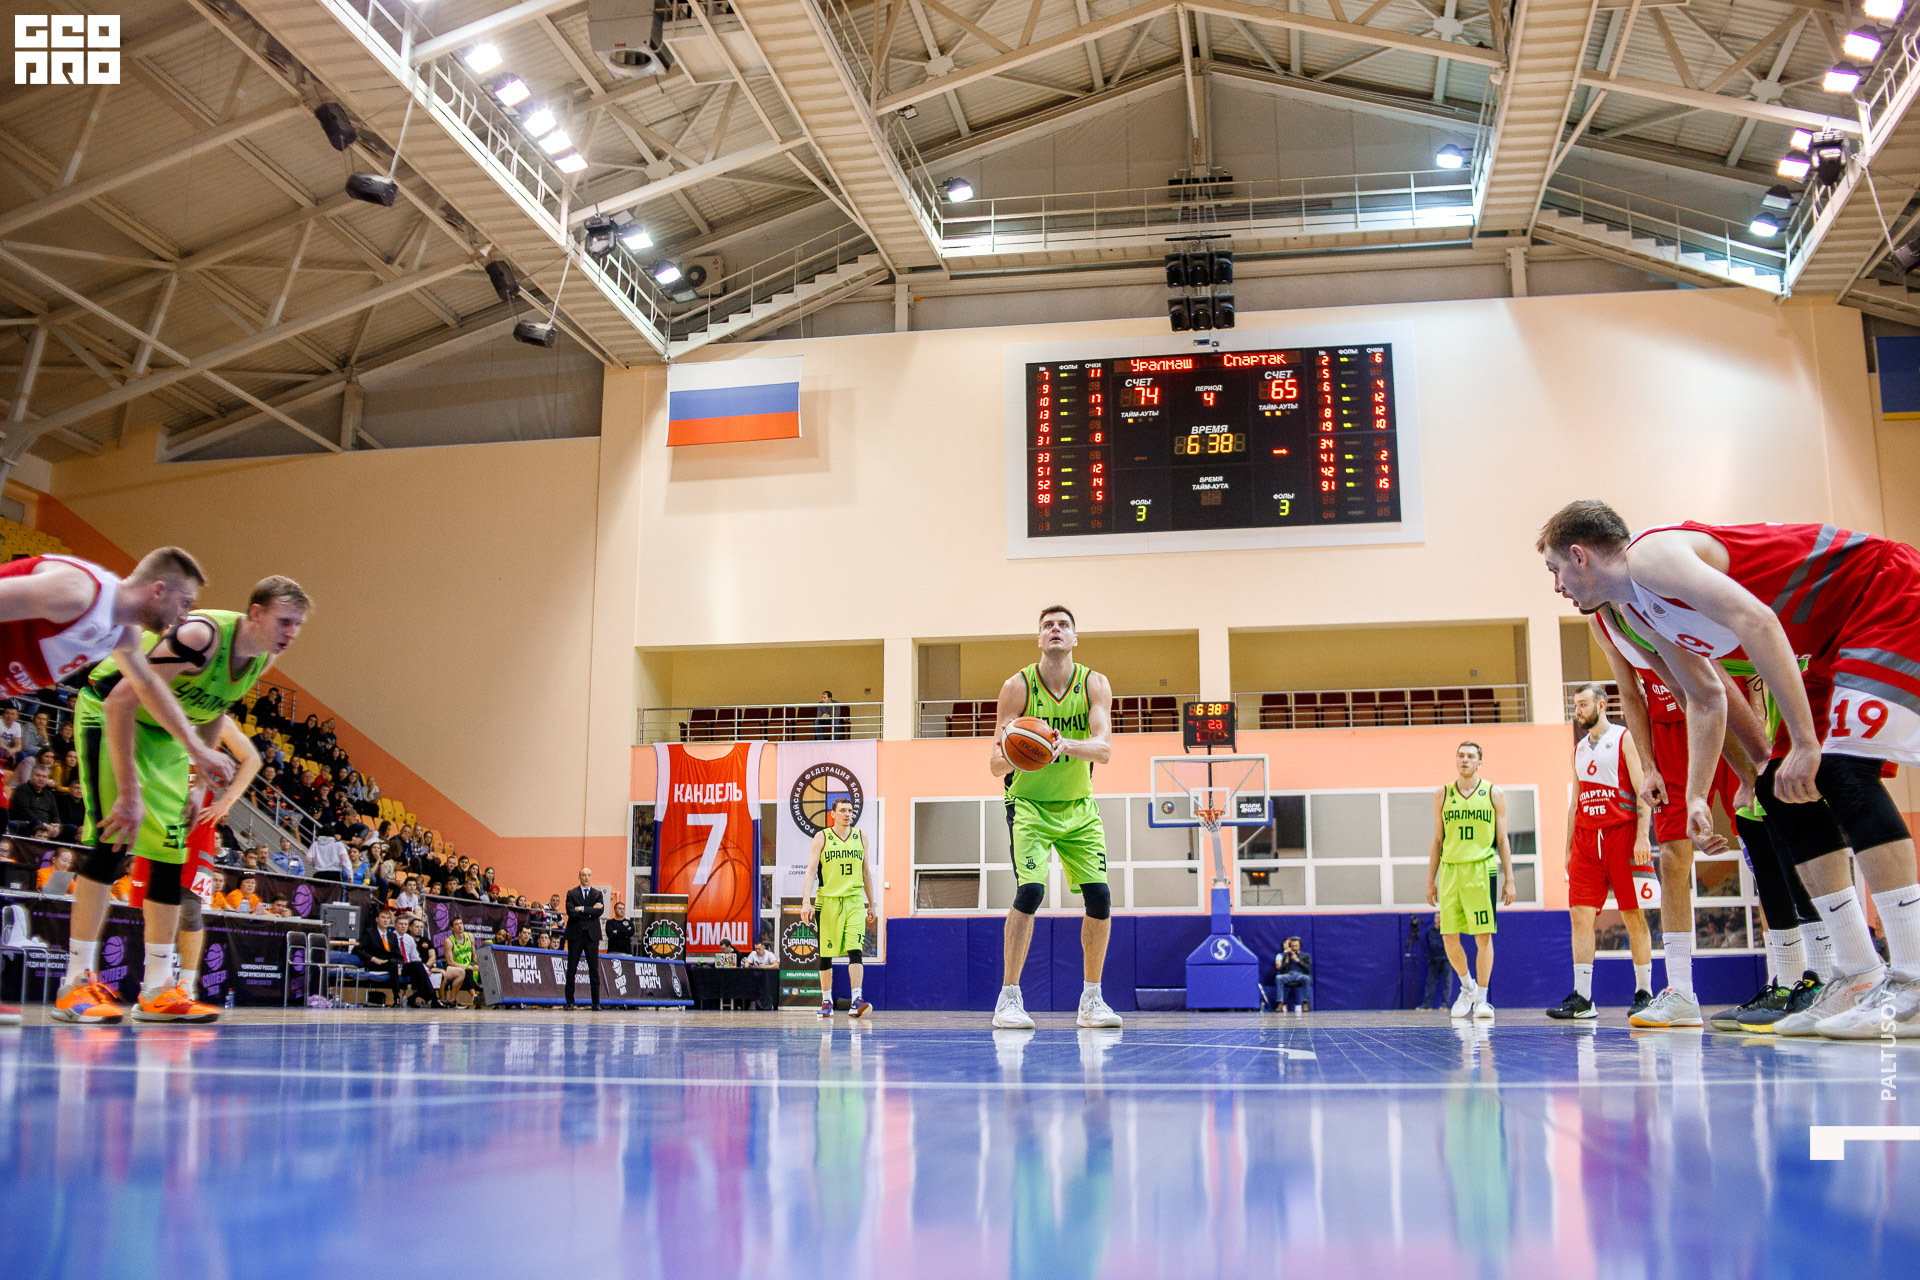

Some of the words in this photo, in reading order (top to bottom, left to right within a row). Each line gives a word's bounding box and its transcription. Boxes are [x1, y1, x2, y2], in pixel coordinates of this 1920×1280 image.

[1131, 358, 1193, 371] Уралмаш
[1223, 353, 1287, 367] Спартак
[1321, 355, 1329, 366] 2
[1375, 352, 1383, 363] 6
[1043, 371, 1050, 380] 7
[1264, 370, 1294, 380] СЧЕТ
[1322, 368, 1330, 379] 5
[1124, 378, 1154, 387] СЧЕТ
[1195, 384, 1222, 392] ПЕРИОД
[1322, 382, 1330, 392] 6
[1376, 379, 1384, 388] 4
[1042, 384, 1049, 394] 9
[1271, 379, 1298, 400] 65
[1040, 396, 1049, 407] 10
[1134, 387, 1160, 406] 74
[1203, 392, 1215, 406] 4
[1258, 402, 1298, 411] ТАЙМ-АУТЫ
[1040, 410, 1050, 420] 13
[1120, 410, 1159, 418] ТАЙМ-АУТЫ
[1324, 408, 1332, 418] 8
[1040, 422, 1050, 432] 16
[1190, 425, 1228, 435] ВРЕМЯ
[1322, 422, 1333, 432] 19
[1038, 436, 1050, 446] 31
[1094, 432, 1102, 442] 8
[1187, 434, 1200, 455] 6
[1207, 433, 1234, 454] 38
[1320, 438, 1334, 450] 34
[1038, 453, 1050, 463] 33
[1320, 452, 1334, 462] 41
[1380, 450, 1388, 460] 2
[1038, 466, 1050, 477] 51
[1320, 466, 1335, 477] 42
[1380, 464, 1389, 474] 4
[1038, 480, 1050, 490] 52
[1192, 482, 1229, 490] ТАЙМ-АУТА
[1322, 480, 1336, 491] 91
[1038, 493, 1050, 504] 98
[1096, 490, 1103, 501] 5
[1130, 498, 1152, 506] ФОЛЫ
[1272, 492, 1295, 500] ФОЛЫ
[1136, 505, 1147, 522] 3
[1279, 500, 1290, 516] 3
[1831, 699, 1889, 740] 19
[1018, 739, 1048, 760] molten
[1586, 760, 1598, 776] 6
[674, 782, 743, 804] КАНДЕЛЬ
[792, 781, 815, 834] РОССИЙСКАЯ
[804, 766, 850, 780] ФЕДЕРАЦИЯ
[1589, 804, 1607, 816] ВТБ
[1444, 809, 1492, 824] УРАЛМАШ
[1458, 826, 1474, 840] 10
[686, 812, 728, 885] 7
[840, 863, 852, 876] 13
[1640, 882, 1653, 900] 6
[1474, 910, 1489, 926] 10
[648, 936, 680, 947] УРАЛМАШ
[508, 954, 538, 970] ПАРИ
[512, 968, 542, 984] МАТЧ
